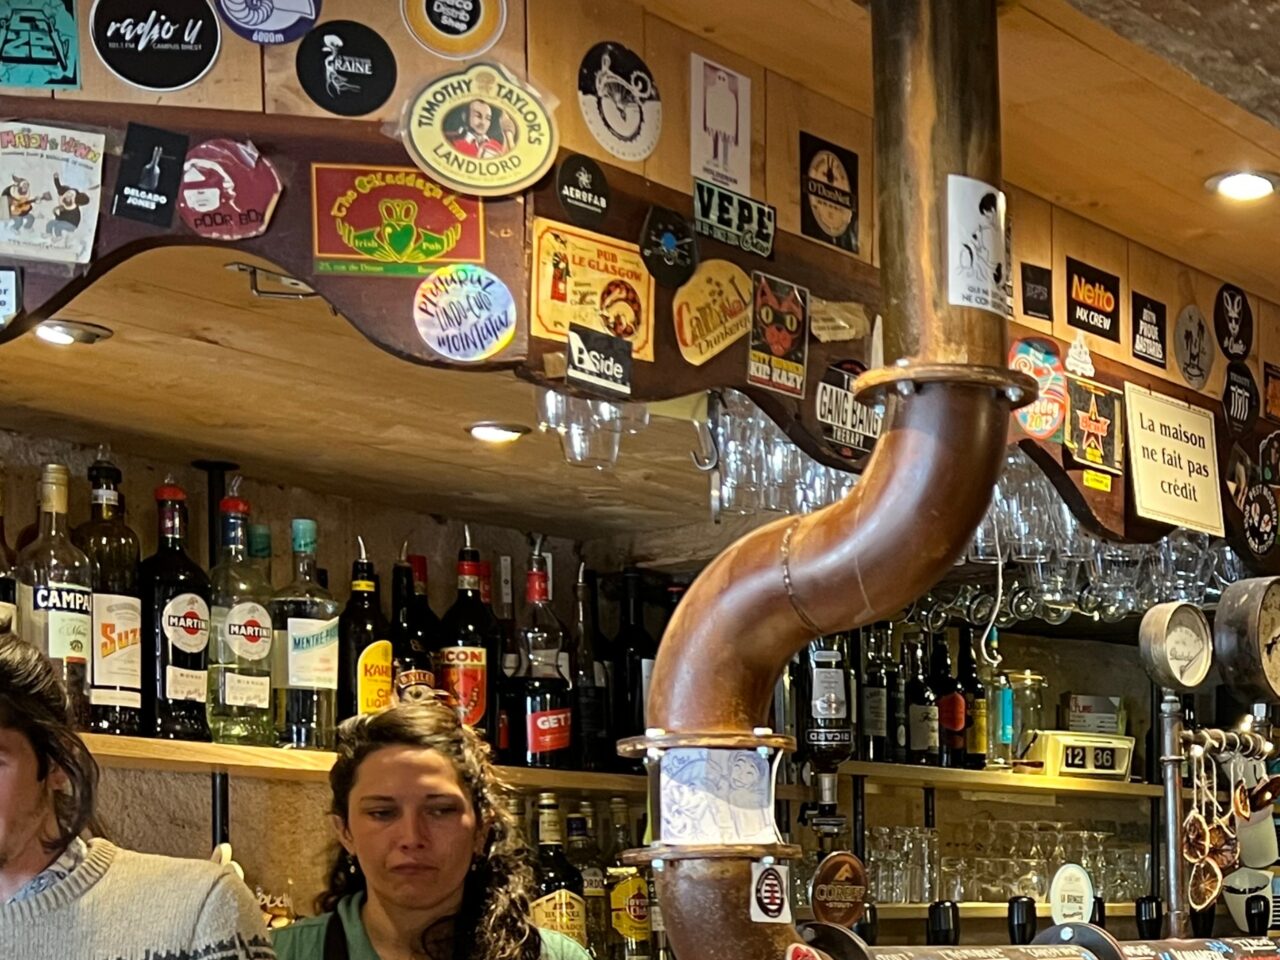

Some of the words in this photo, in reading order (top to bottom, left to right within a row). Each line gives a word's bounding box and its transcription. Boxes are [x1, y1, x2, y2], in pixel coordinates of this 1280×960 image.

[106, 10, 180, 51] radio
[417, 78, 473, 129] TIMOTHY
[496, 82, 546, 147] TAYLOR'S
[432, 142, 522, 177] LANDLORD
[123, 186, 168, 205] DELGADO
[126, 196, 157, 211] JONES
[561, 184, 607, 210] AEROFAB
[193, 212, 233, 229] POOR
[572, 253, 588, 267] LE
[587, 257, 643, 283] GLASGOW
[596, 248, 618, 264] PUB
[1071, 274, 1115, 313] Netto
[1088, 310, 1112, 331] CREW
[819, 385, 849, 425] GANG
[849, 401, 882, 436] BANG
[832, 425, 864, 447] THERAPY
[1139, 412, 1155, 433] La
[1159, 421, 1206, 450] maison
[1141, 445, 1158, 463] ne
[1162, 448, 1183, 470] fait
[1187, 459, 1210, 478] pas
[1160, 478, 1198, 503] crédit
[36, 588, 92, 612] CAMPA
[441, 650, 483, 663] ICON
[808, 731, 850, 741] RICARD
[1065, 747, 1084, 765] 12
[1094, 748, 1113, 767] 36
